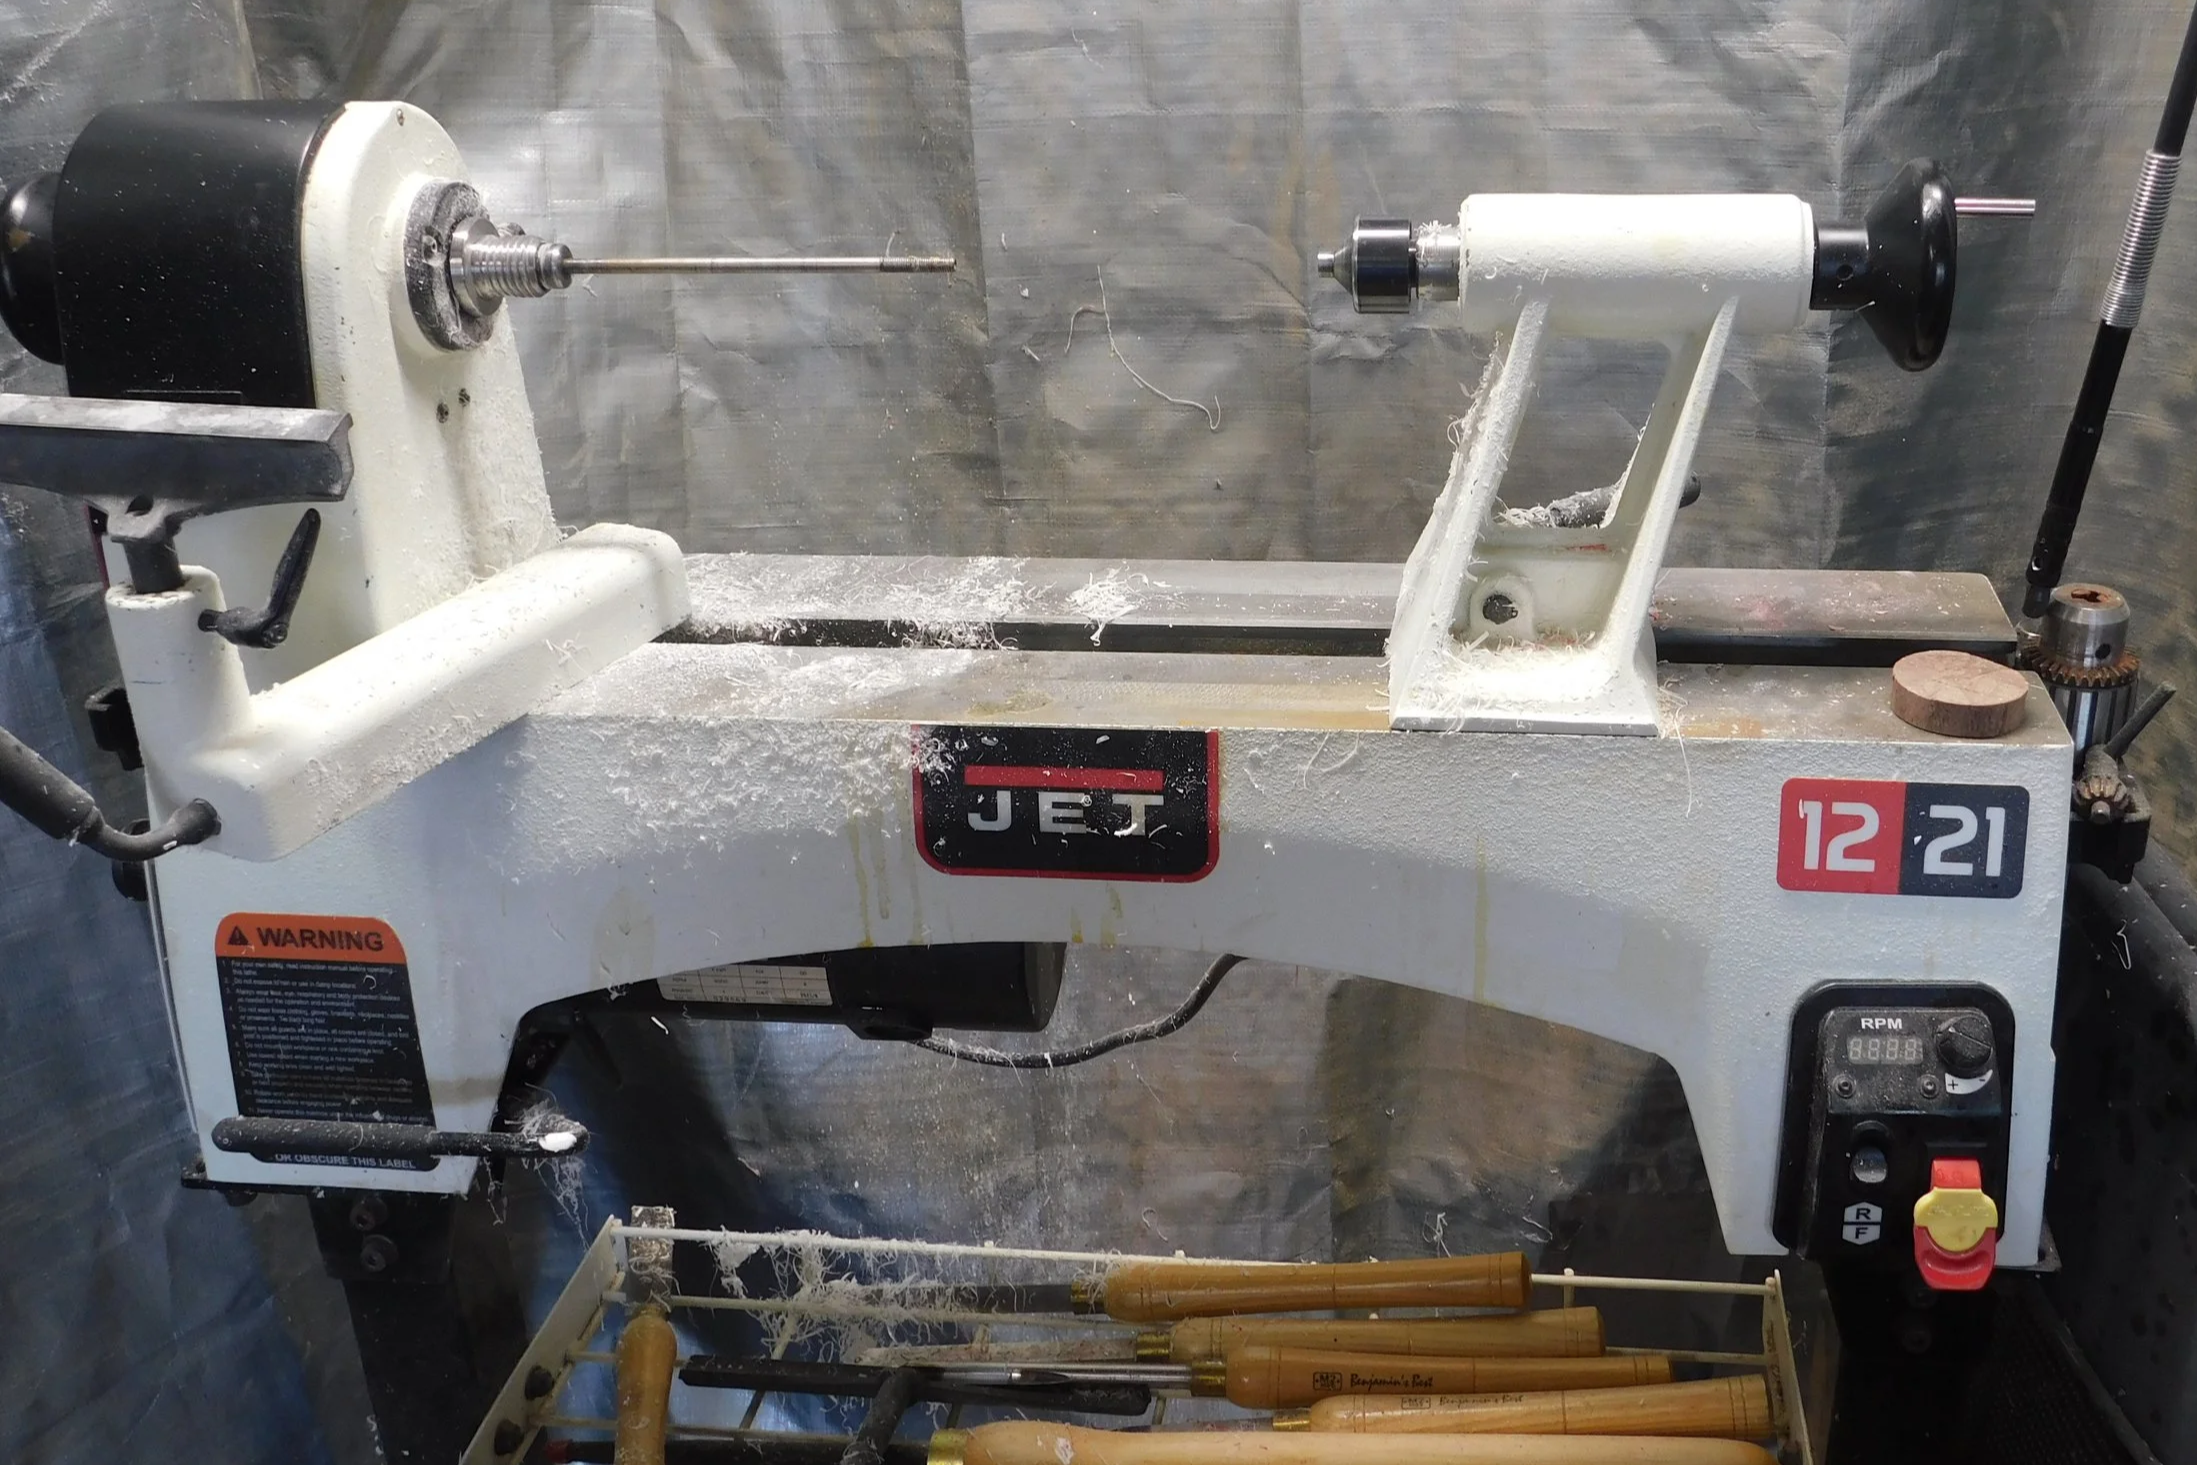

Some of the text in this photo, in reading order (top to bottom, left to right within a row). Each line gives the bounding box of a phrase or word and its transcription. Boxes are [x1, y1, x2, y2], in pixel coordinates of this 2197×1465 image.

[967, 790, 1164, 836] JET
[1801, 800, 2006, 877] 12 21
[256, 927, 384, 951] WARNING
[1861, 1018, 1902, 1029] RPM
[275, 1153, 416, 1169] OR OBSCURE THIS LABEL
[1855, 1208, 1871, 1220] R
[1854, 1227, 1868, 1239] F
[1350, 1373, 1409, 1392] Benjamin's
[1411, 1373, 1434, 1388] Best
